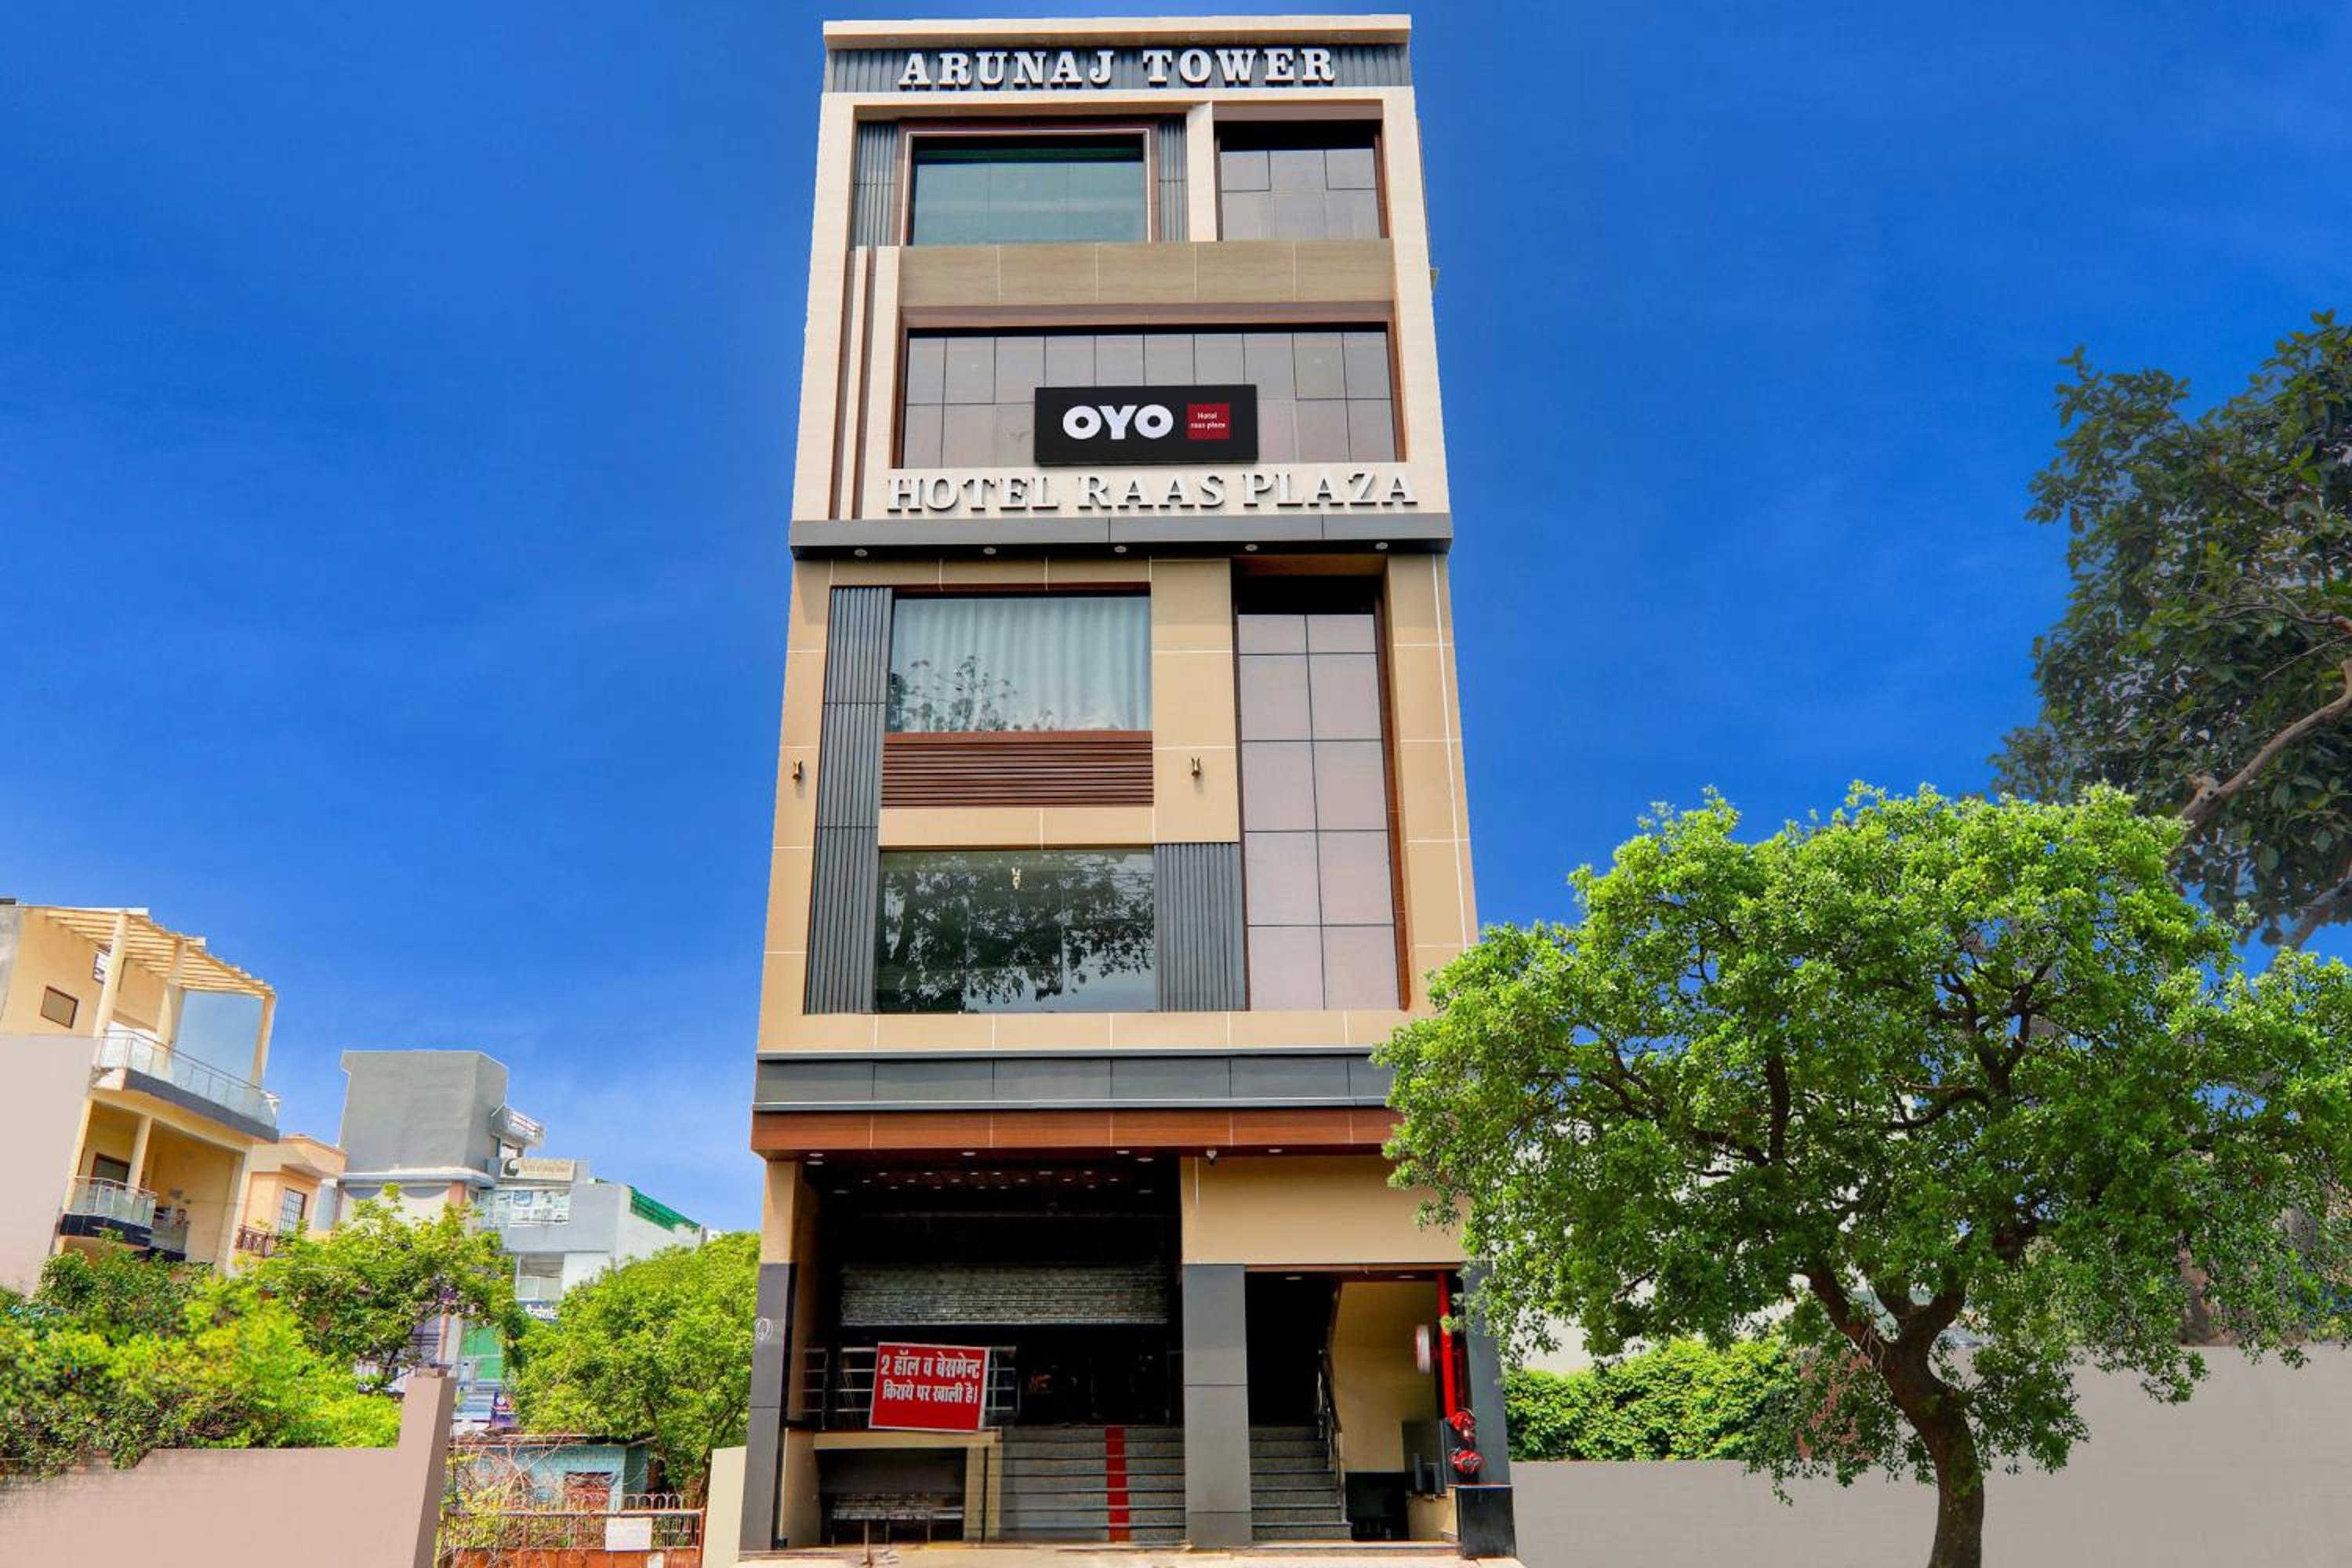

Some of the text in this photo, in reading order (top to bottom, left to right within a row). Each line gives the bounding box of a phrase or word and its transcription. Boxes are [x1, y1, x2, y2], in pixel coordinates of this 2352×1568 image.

[898, 49, 1335, 87] ARUNAJ TOWER
[1062, 404, 1174, 440] OYO
[887, 470, 1418, 512] HOTEL RAAS PLAZA
[880, 1355, 891, 1375] 2
[894, 1349, 920, 1377] हॉल
[923, 1357, 935, 1377] व
[882, 1379, 914, 1400] किराये
[916, 1385, 931, 1402] पर
[932, 1381, 964, 1403] खाली
